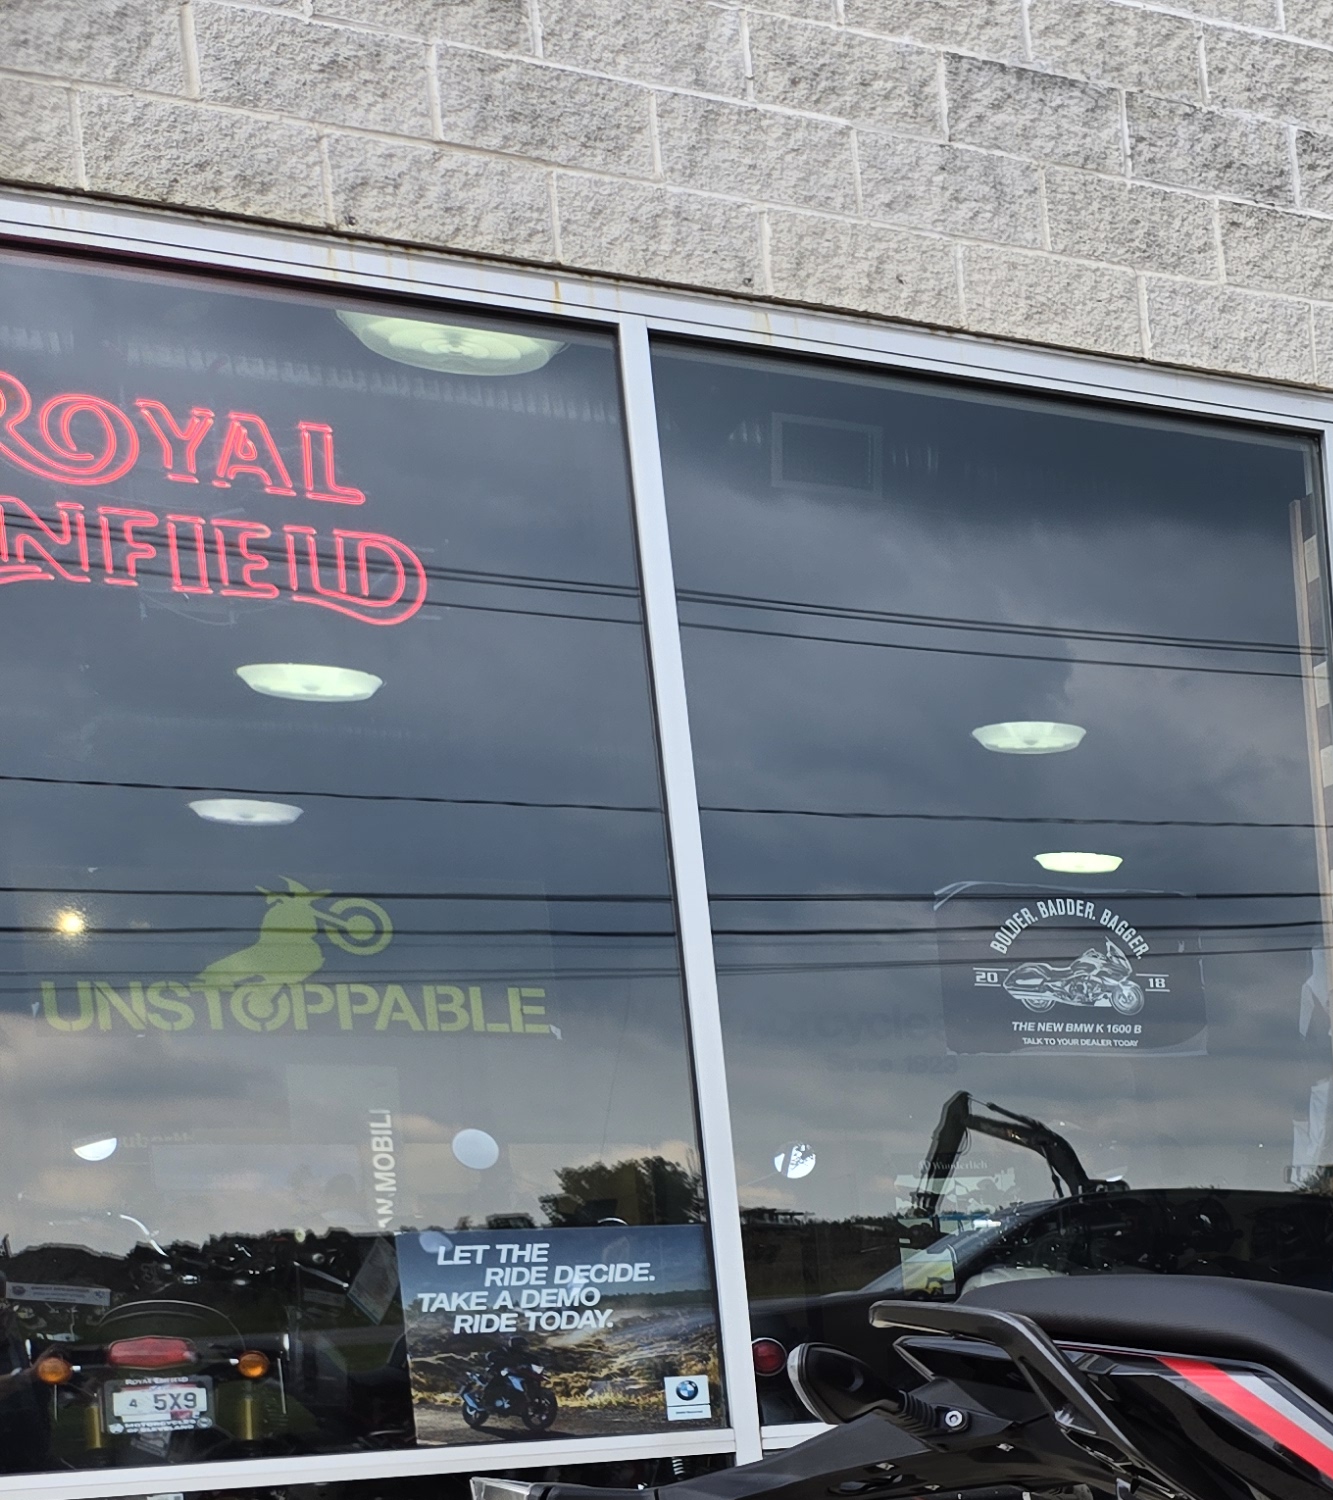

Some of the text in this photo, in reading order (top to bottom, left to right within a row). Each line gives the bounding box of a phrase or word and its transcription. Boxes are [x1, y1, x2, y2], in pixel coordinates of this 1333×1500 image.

[0, 496, 427, 626] NFIELD
[990, 899, 1150, 959] BOLDER. BADDER. BAGGER.
[975, 971, 1167, 989] 20 18
[40, 980, 551, 1034] UNSTOPPABLE
[1012, 1022, 1142, 1034] THE NEW BMW K 1600 B
[1022, 1037, 1139, 1047] TALK TO YOUR DEALER TODAY
[437, 1243, 550, 1266] LET THE
[484, 1262, 656, 1287] RIDE DECIDE.
[417, 1287, 601, 1313] TAKE A DEMO
[453, 1309, 614, 1334] RIDE TODAY.
[153, 1391, 197, 1411] 5X9
